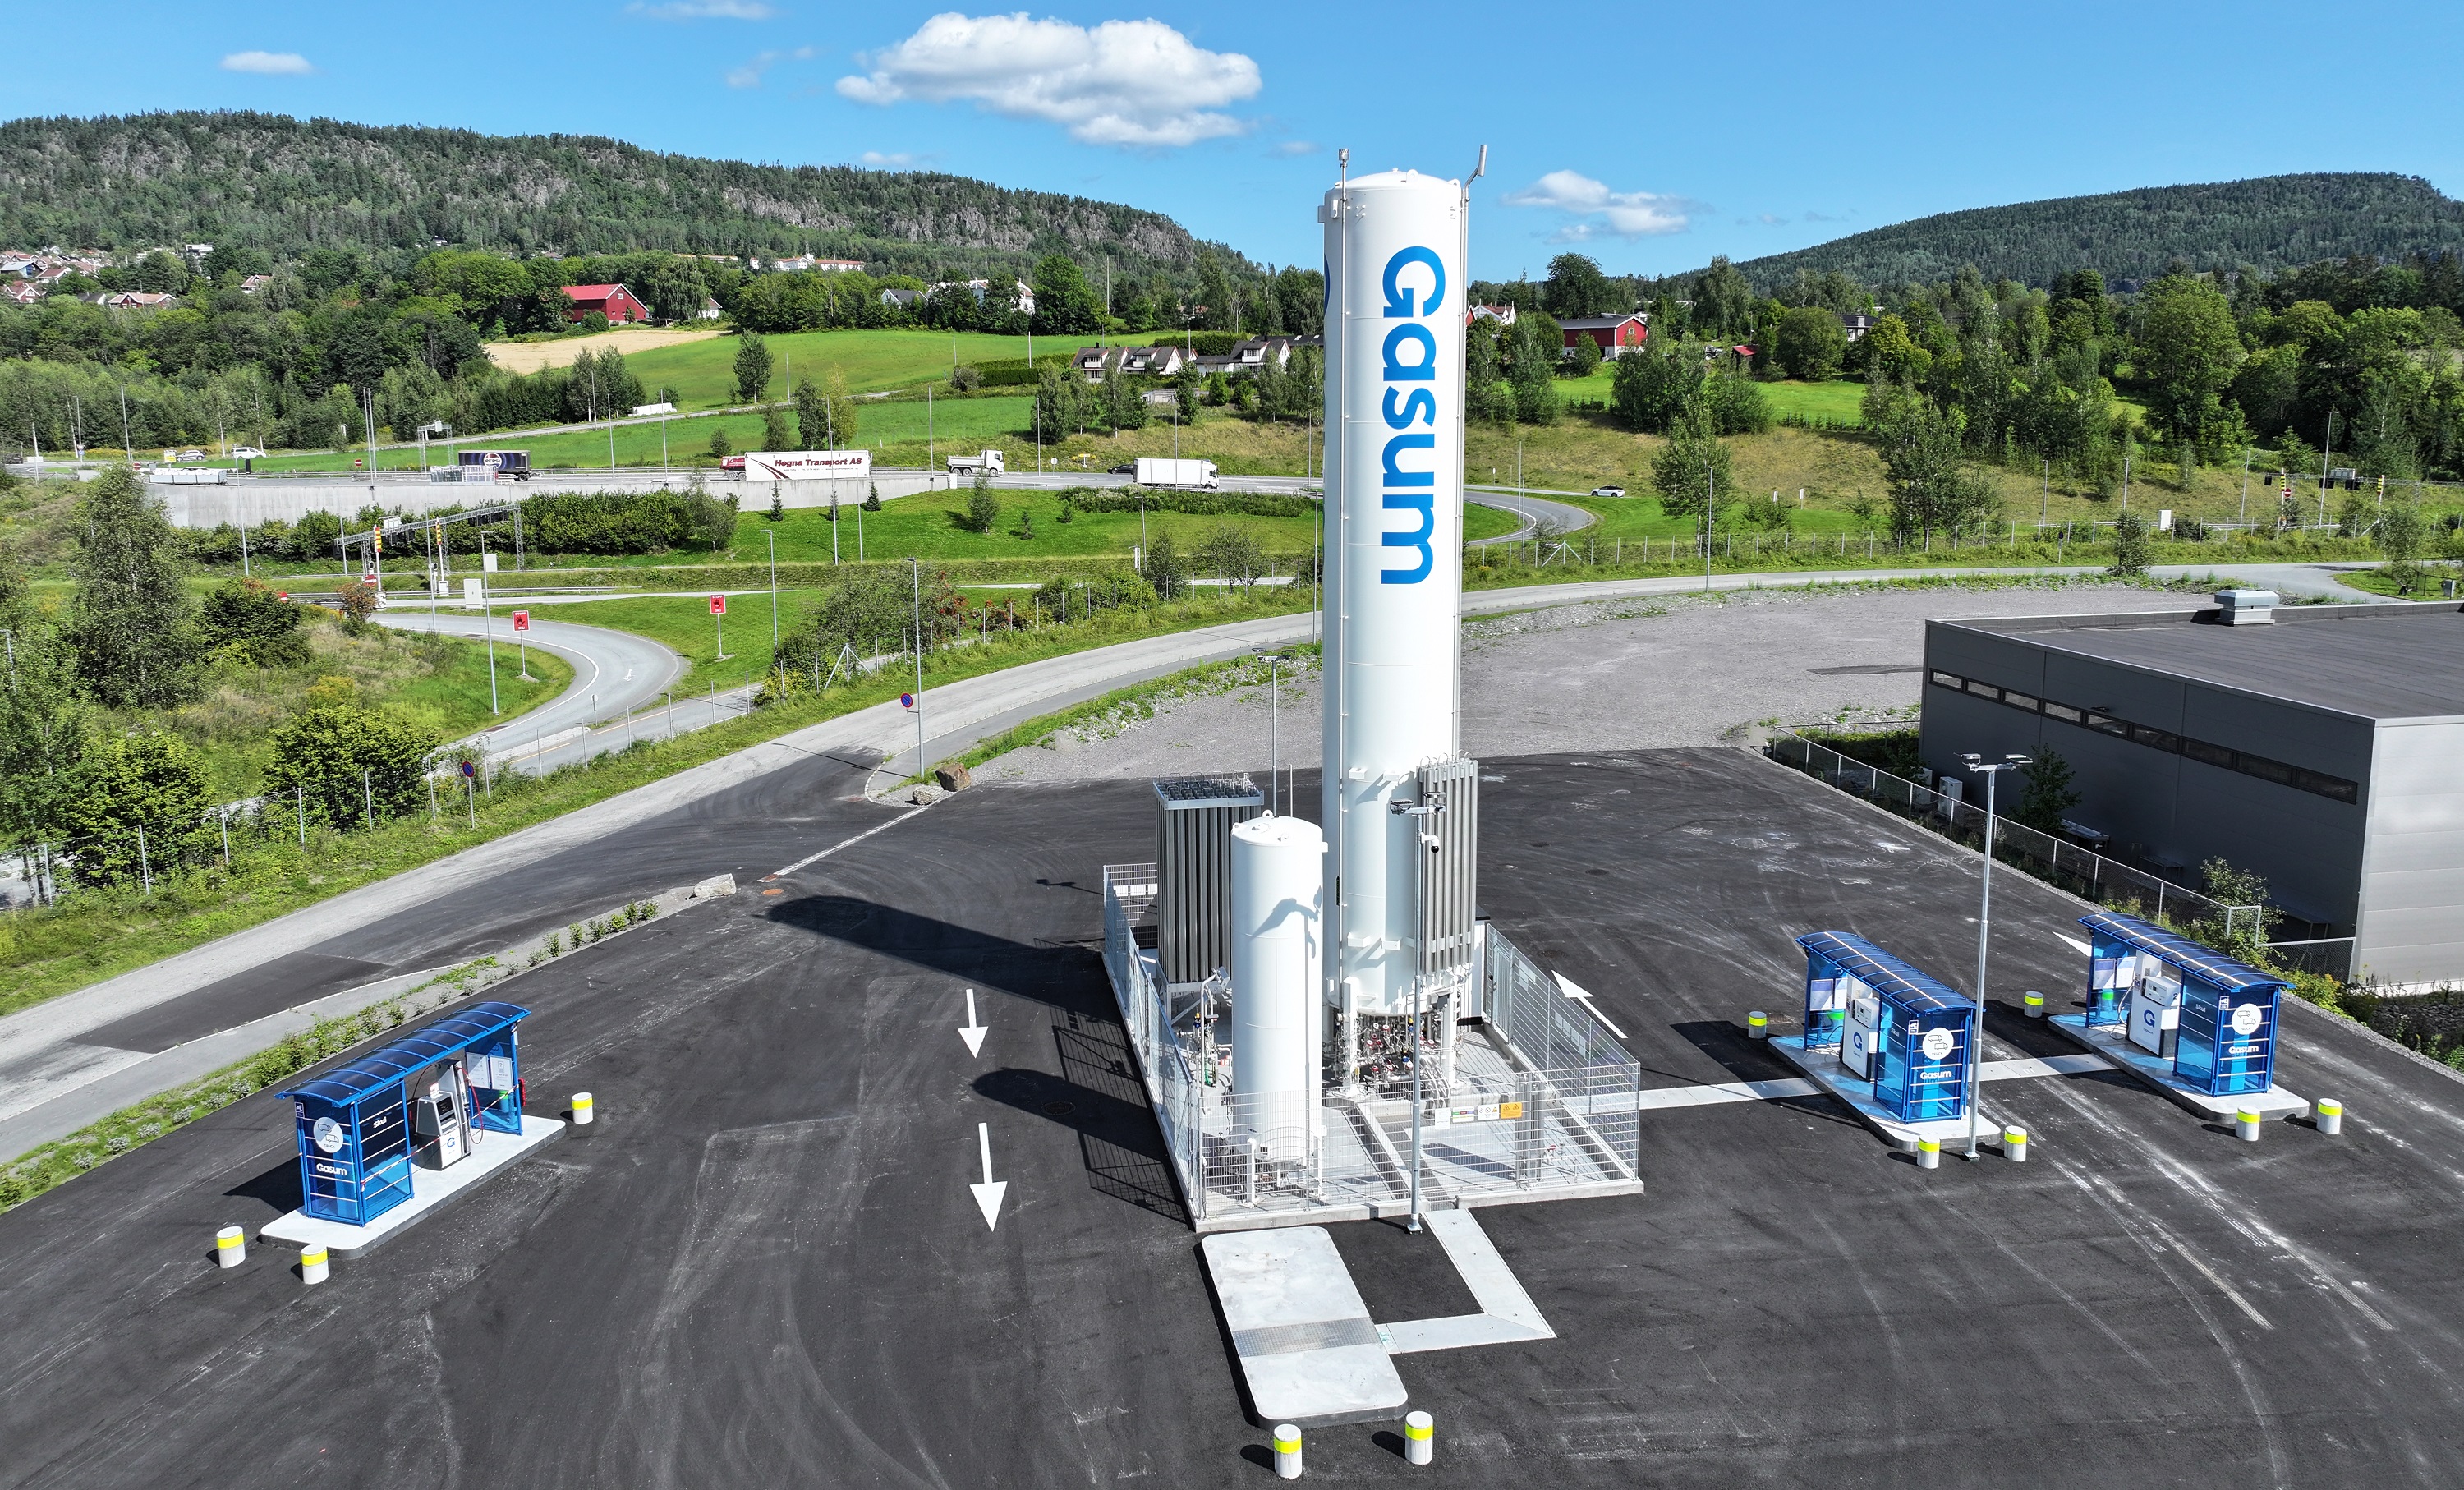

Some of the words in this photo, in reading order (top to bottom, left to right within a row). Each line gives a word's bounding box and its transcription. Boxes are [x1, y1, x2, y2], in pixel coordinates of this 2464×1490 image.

[1381, 246, 1446, 584] Gasum
[775, 459, 802, 467] Hegna
[805, 458, 848, 467] Transport
[2172, 992, 2178, 1000] 2
[2143, 1009, 2156, 1028] G
[1853, 1032, 1863, 1051] G
[2228, 1045, 2259, 1055] Gasum
[1919, 1070, 1952, 1080] Gasum
[446, 1137, 456, 1148] G
[316, 1162, 347, 1176] Gasum
